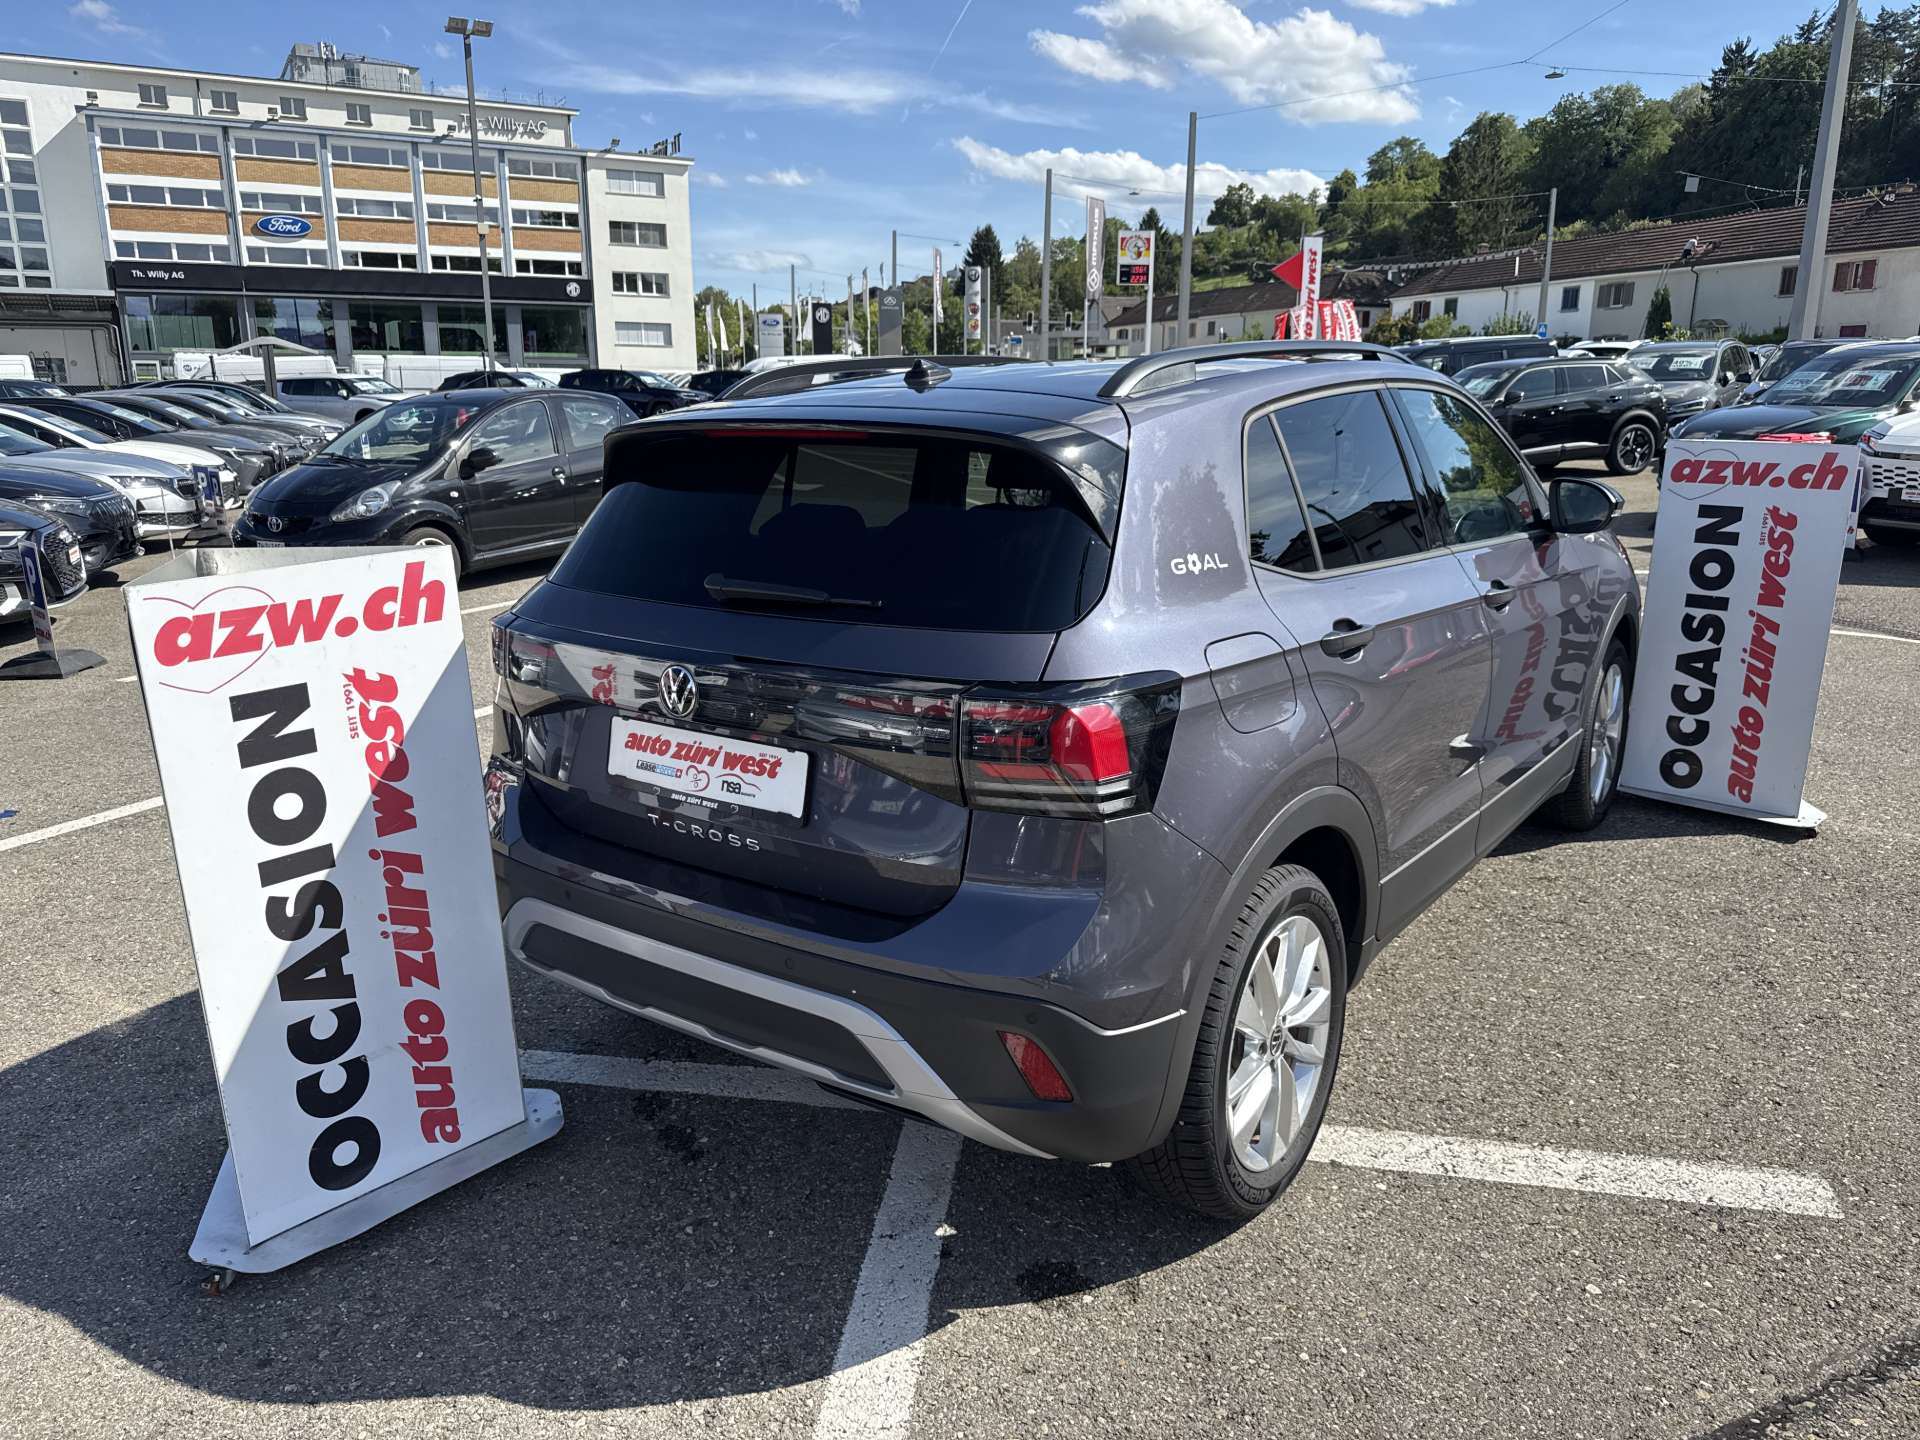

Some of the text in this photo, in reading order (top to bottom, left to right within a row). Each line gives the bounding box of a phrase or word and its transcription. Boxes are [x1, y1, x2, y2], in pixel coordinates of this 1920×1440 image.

[488, 115, 524, 133] Willy
[526, 119, 548, 134] AG
[268, 218, 302, 234] Ford
[131, 269, 185, 281] Th. Willy AG
[1670, 452, 1849, 491] azw.ch
[24, 556, 36, 598] P
[1170, 553, 1229, 575] GOAL
[154, 561, 446, 667] azw.ch
[1659, 504, 1744, 789] OCCASION
[1728, 505, 1798, 804] auto züri west
[342, 683, 360, 740] SEIT 1991
[624, 731, 783, 779] auto züri west
[671, 793, 686, 802] auto
[702, 800, 719, 809] west
[721, 780, 742, 795] nsa
[647, 813, 760, 851] T-CROSS
[342, 667, 462, 1144] auto züri west
[229, 682, 381, 1191] OCCASION
